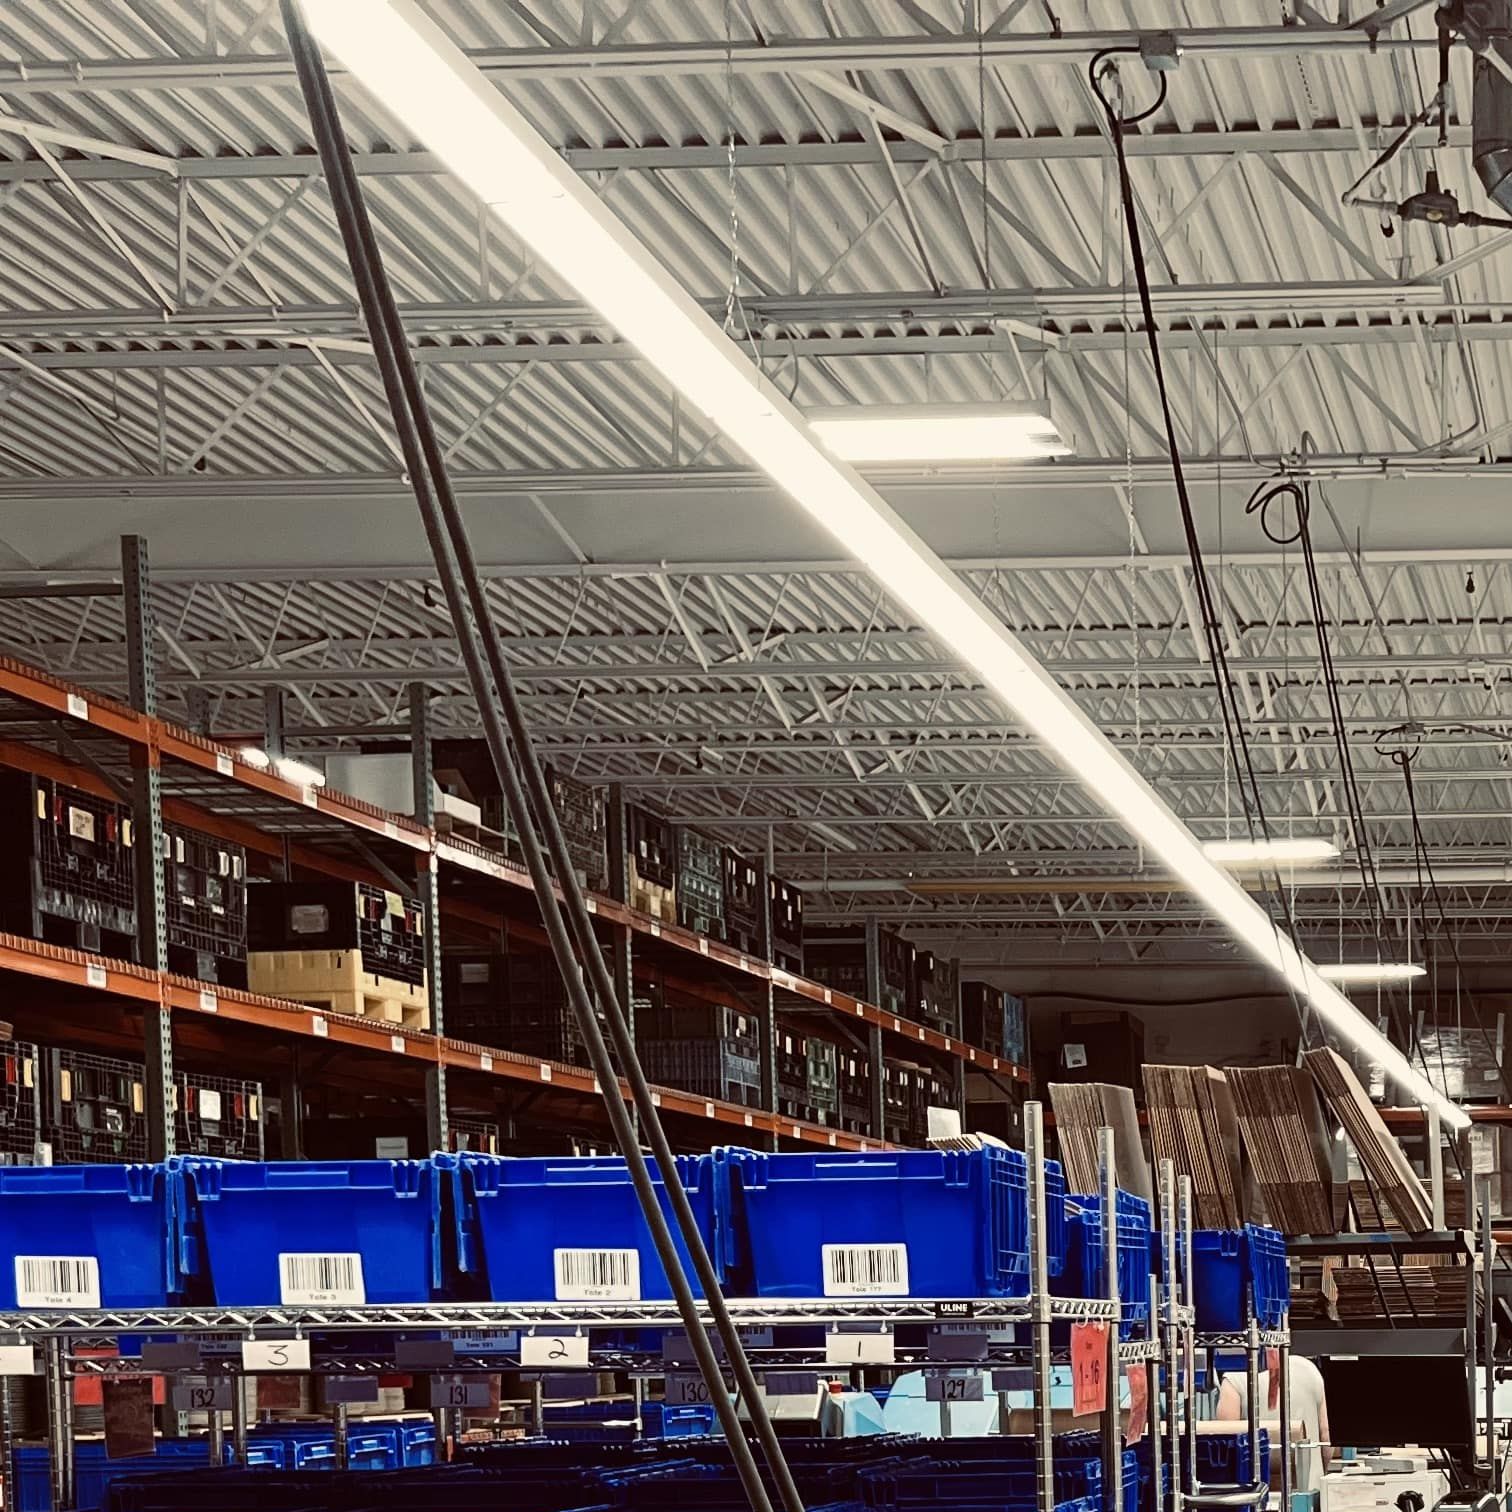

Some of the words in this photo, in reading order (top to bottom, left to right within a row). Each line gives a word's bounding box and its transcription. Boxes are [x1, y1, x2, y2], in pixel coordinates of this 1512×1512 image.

[940, 1303, 968, 1312] ULINE
[267, 1344, 289, 1366] 3
[548, 1339, 569, 1360] 2
[190, 1388, 216, 1409] 132
[449, 1385, 468, 1405] 131
[681, 1381, 709, 1401] 130
[940, 1379, 966, 1400] 129
